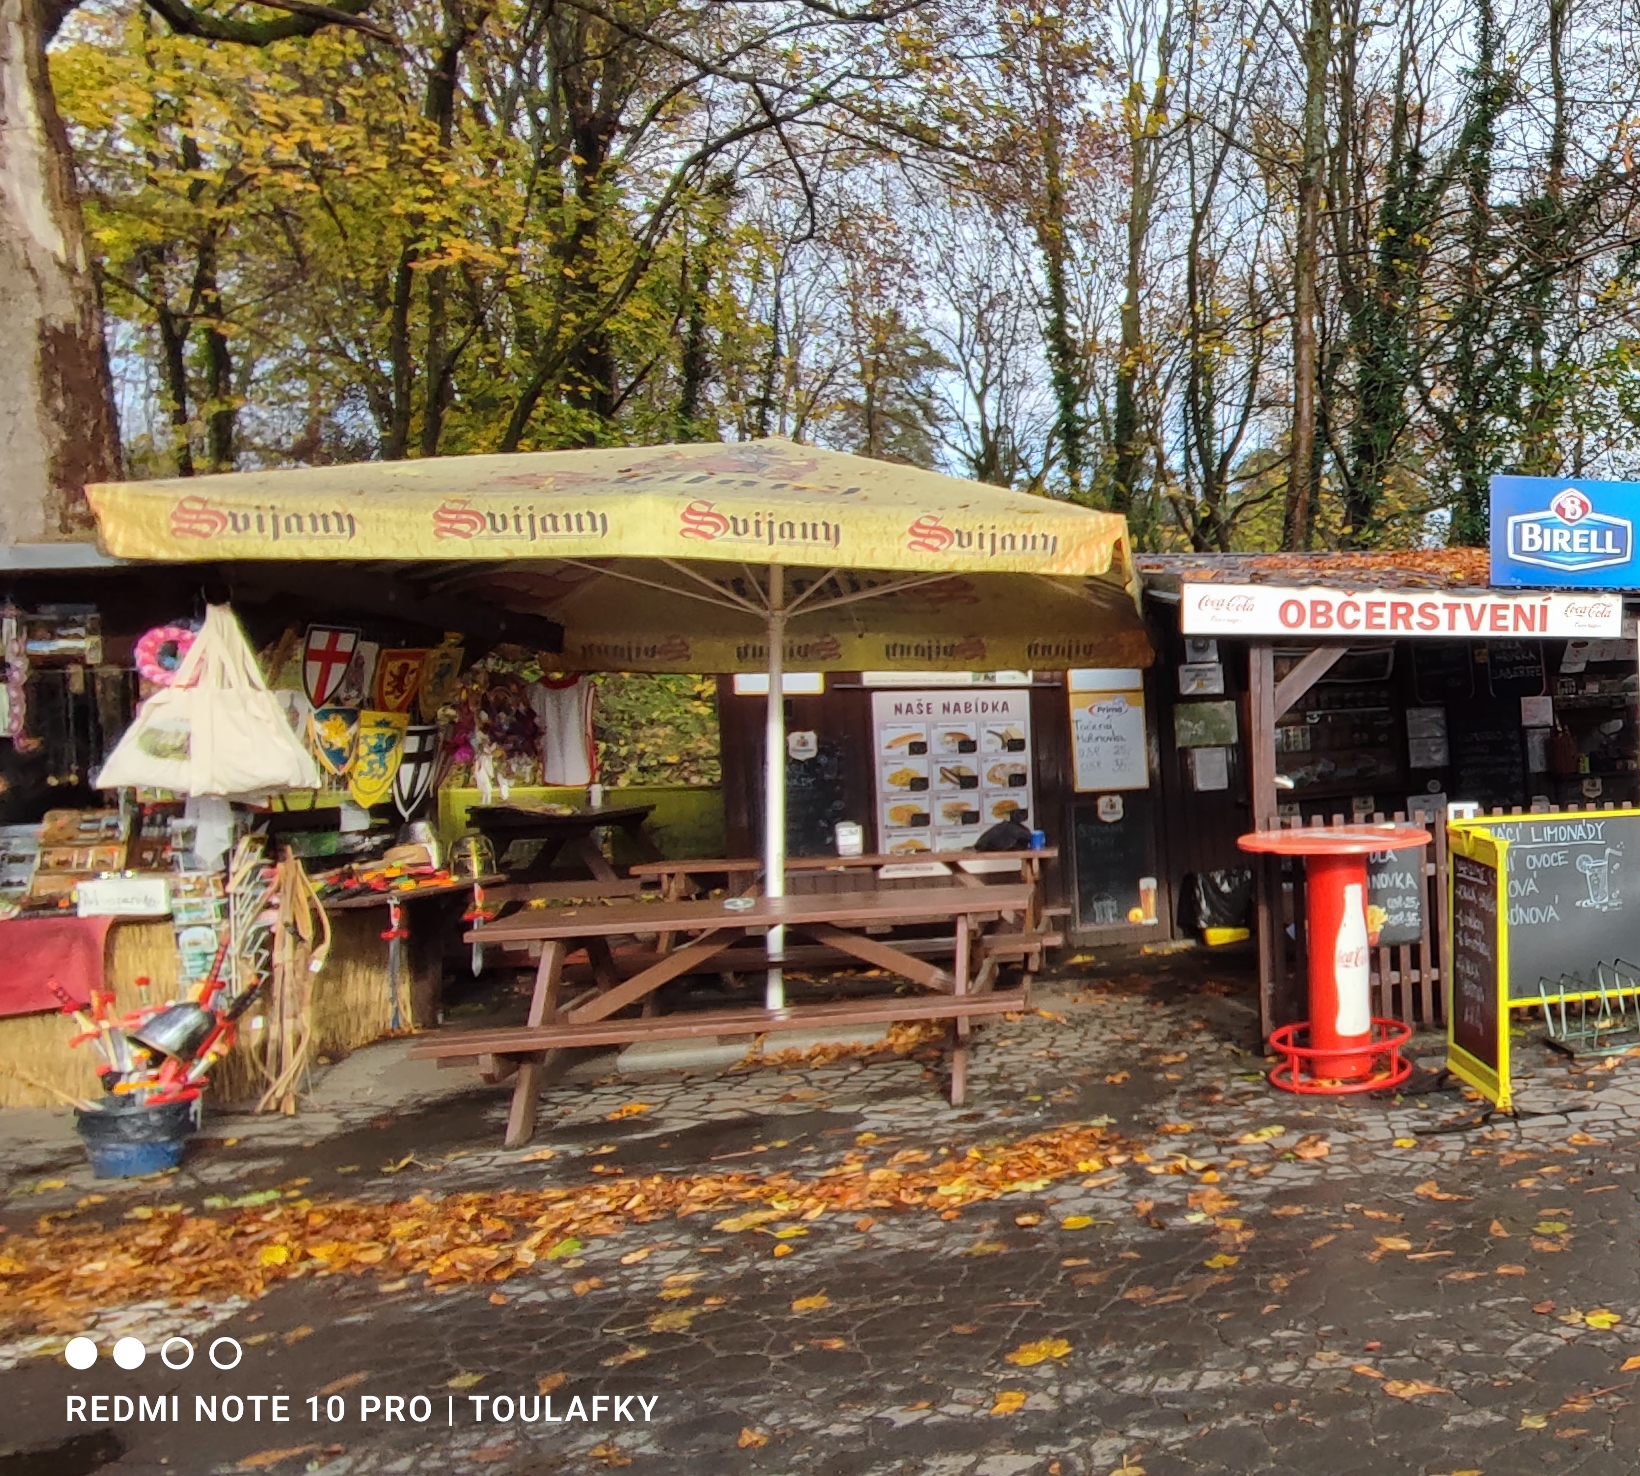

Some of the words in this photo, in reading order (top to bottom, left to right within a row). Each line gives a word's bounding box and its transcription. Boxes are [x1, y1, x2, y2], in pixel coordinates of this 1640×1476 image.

[170, 496, 357, 541] Svijany
[432, 498, 609, 541] Svijany
[679, 499, 841, 549] Svijany
[907, 514, 1058, 557] Svijany
[1521, 522, 1621, 554] BIRELL
[1278, 590, 1553, 632] OBČERSTVENÍ
[894, 698, 933, 716] NAŠE
[942, 697, 1010, 715] NABÍDKA
[1531, 818, 1606, 843] LIMONÁDY
[1526, 851, 1569, 870] OVOCE
[1508, 871, 1539, 898] OVÁ
